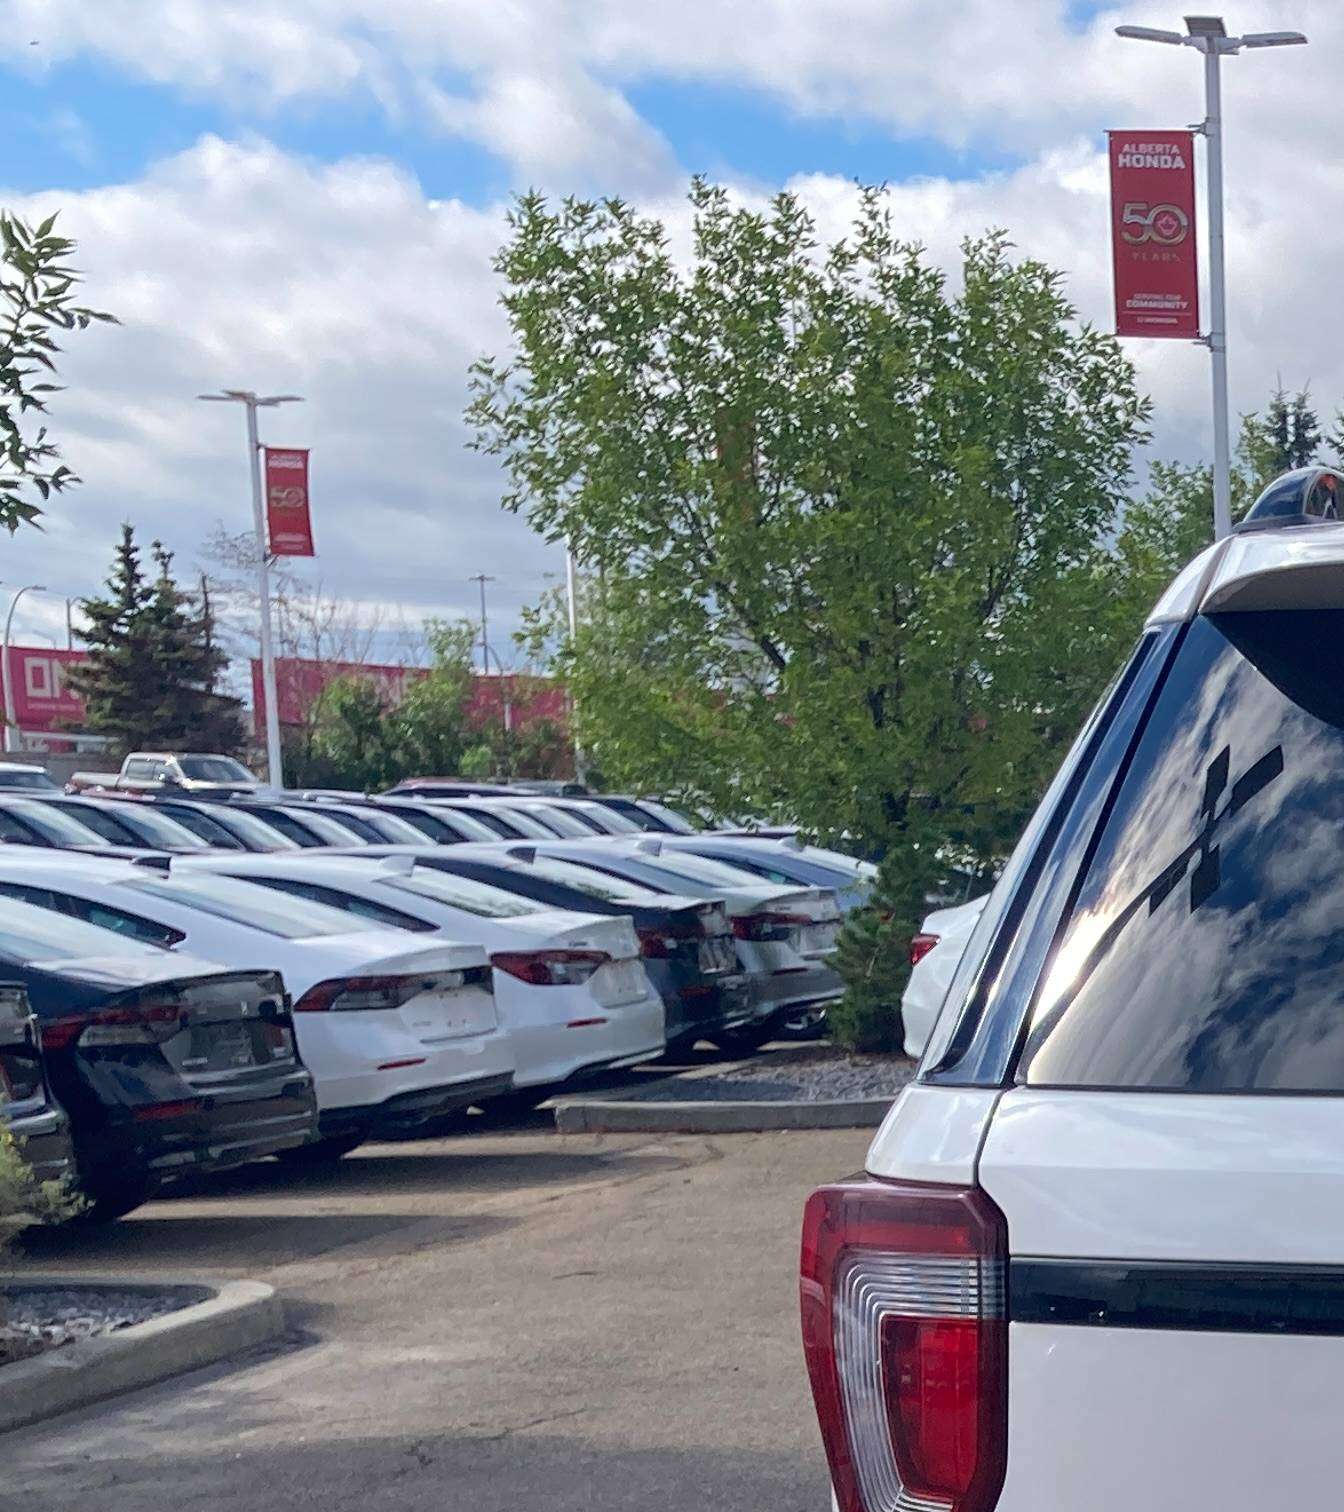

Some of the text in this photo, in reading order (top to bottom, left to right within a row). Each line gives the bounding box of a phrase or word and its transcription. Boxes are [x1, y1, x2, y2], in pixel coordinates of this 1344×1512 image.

[1122, 143, 1180, 155] ALBERTA
[1118, 155, 1186, 169] HONDA
[1121, 203, 1189, 245] 50
